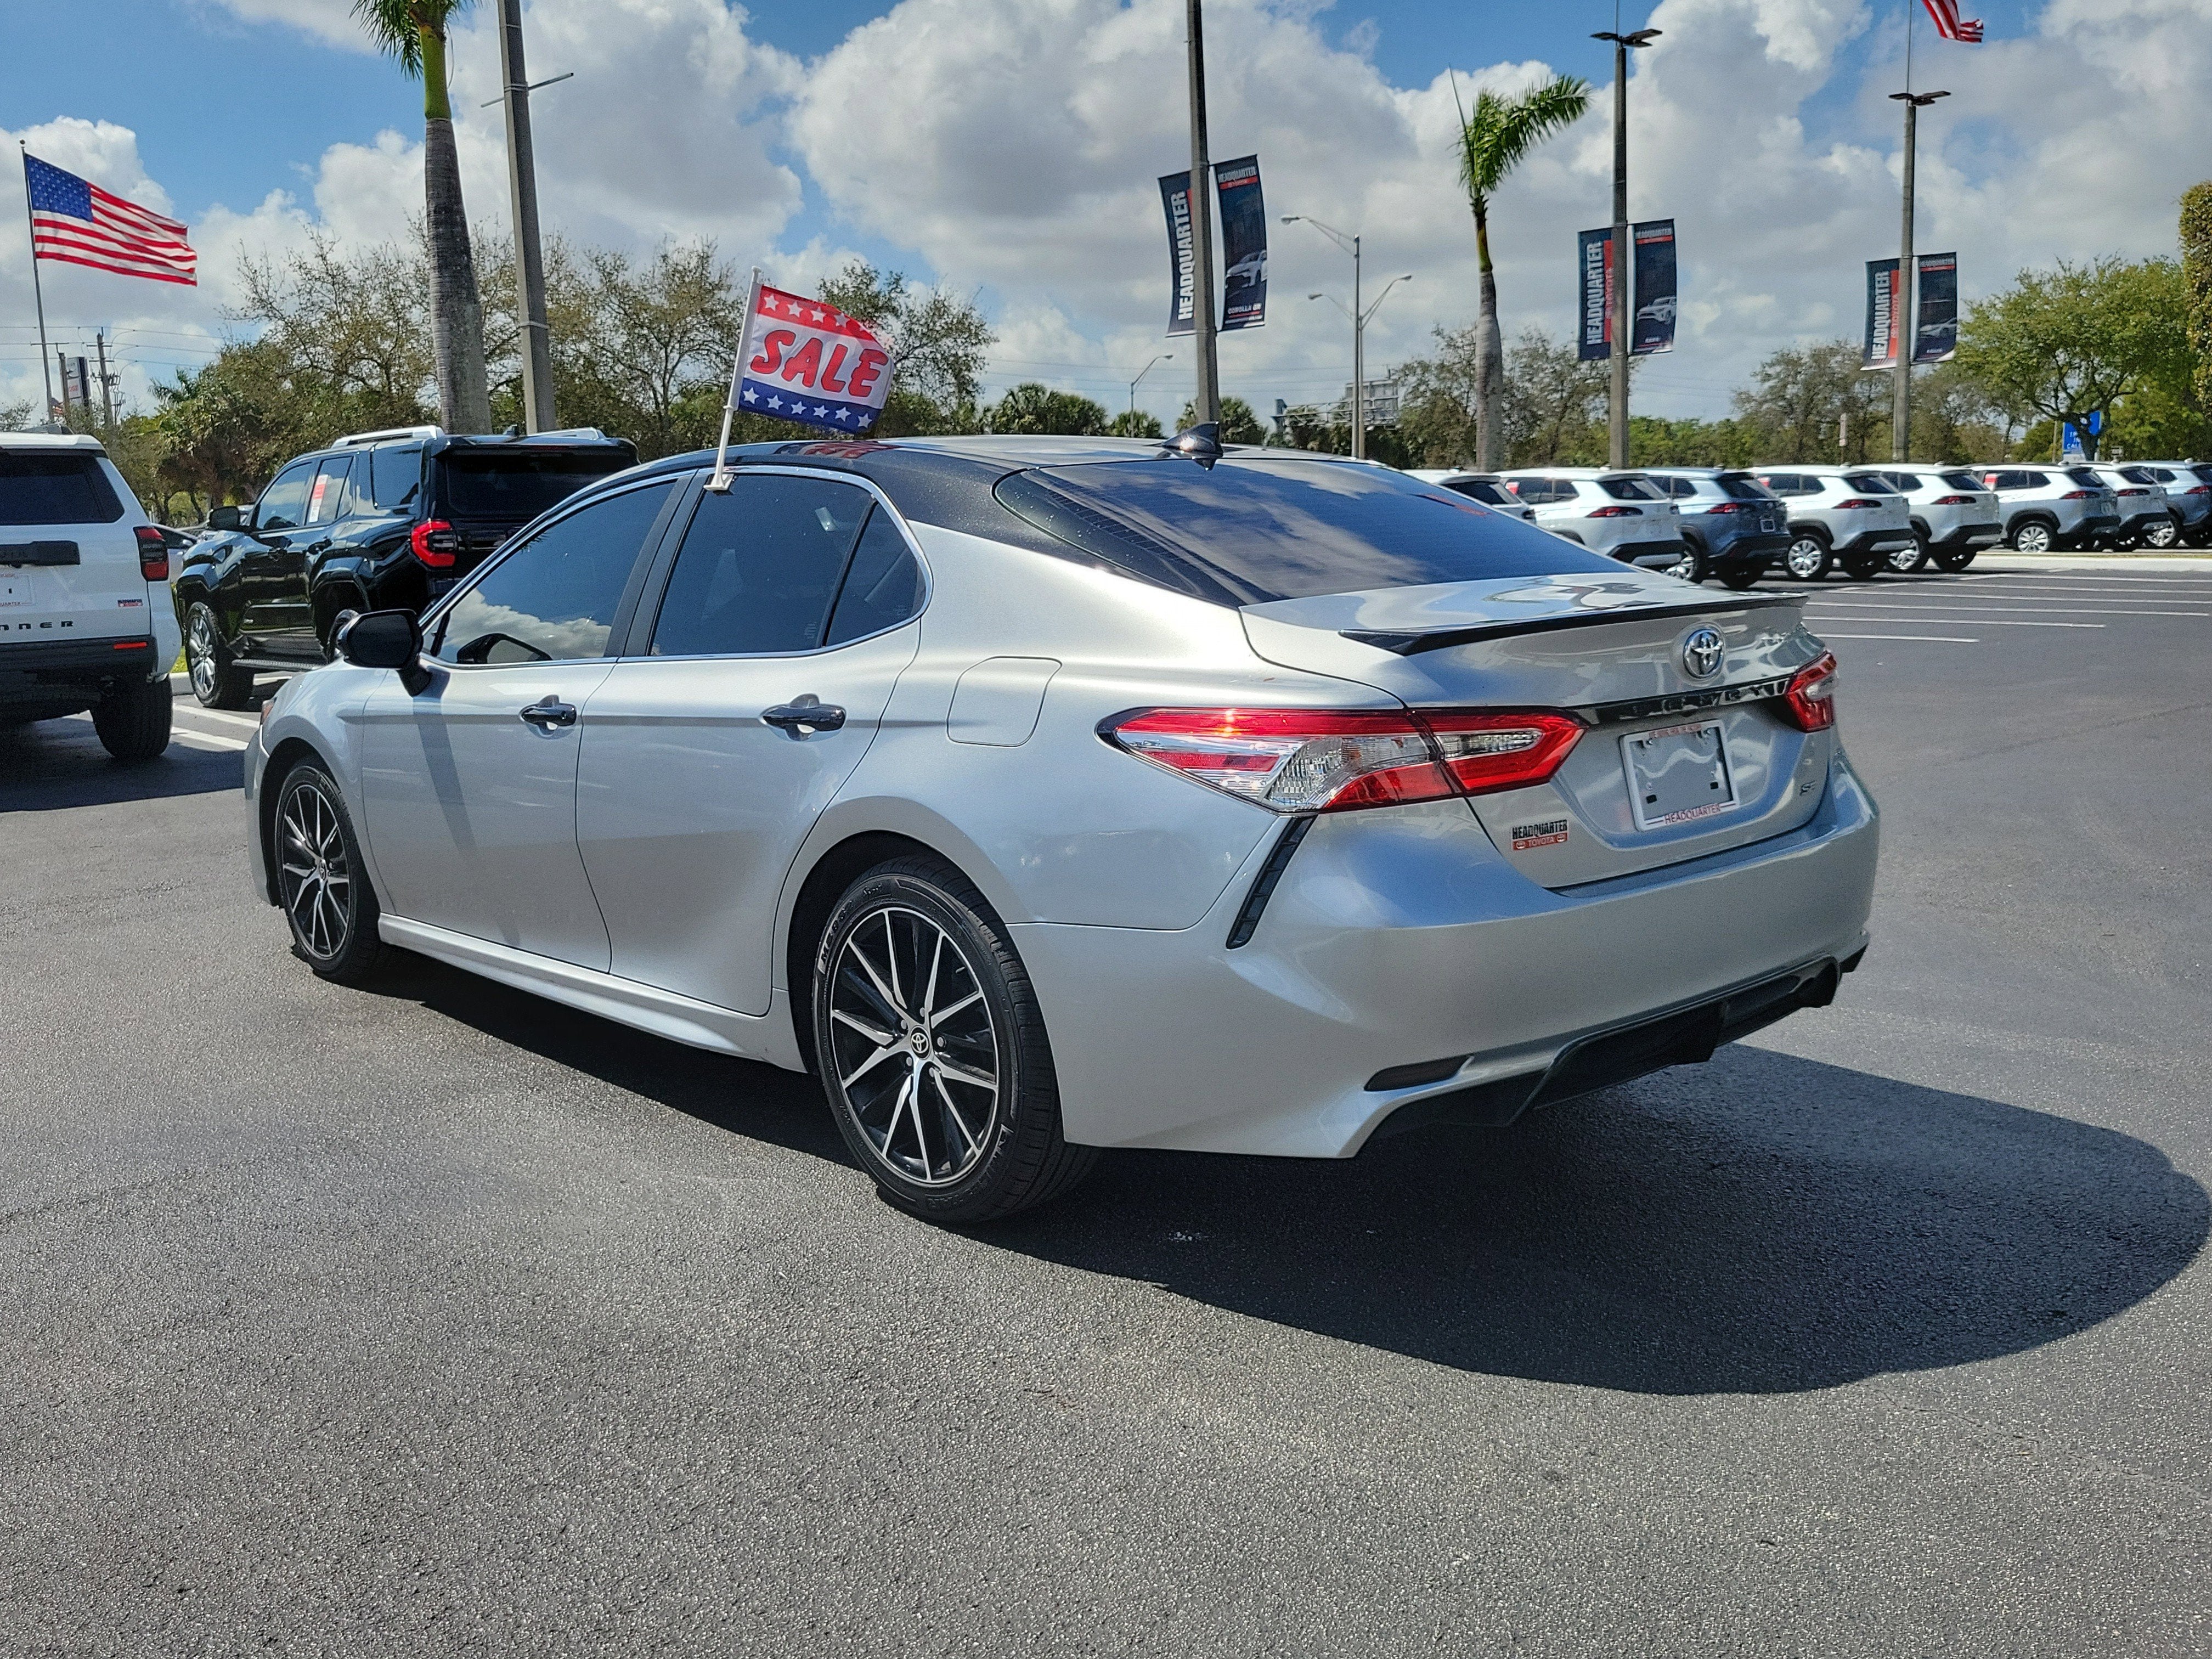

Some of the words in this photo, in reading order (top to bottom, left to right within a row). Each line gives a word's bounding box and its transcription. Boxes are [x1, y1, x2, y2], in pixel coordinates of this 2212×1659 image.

[1170, 190, 1194, 321] HEADQUARTER
[1587, 241, 1605, 345] HEADQUARTER
[1871, 271, 1890, 359] HEADQUARTER
[750, 330, 889, 398] SALE
[1513, 820, 1567, 839] HEADQUARTER
[1527, 836, 1555, 847] TOYOTA
[1664, 803, 1720, 824] HEADQUARTER
